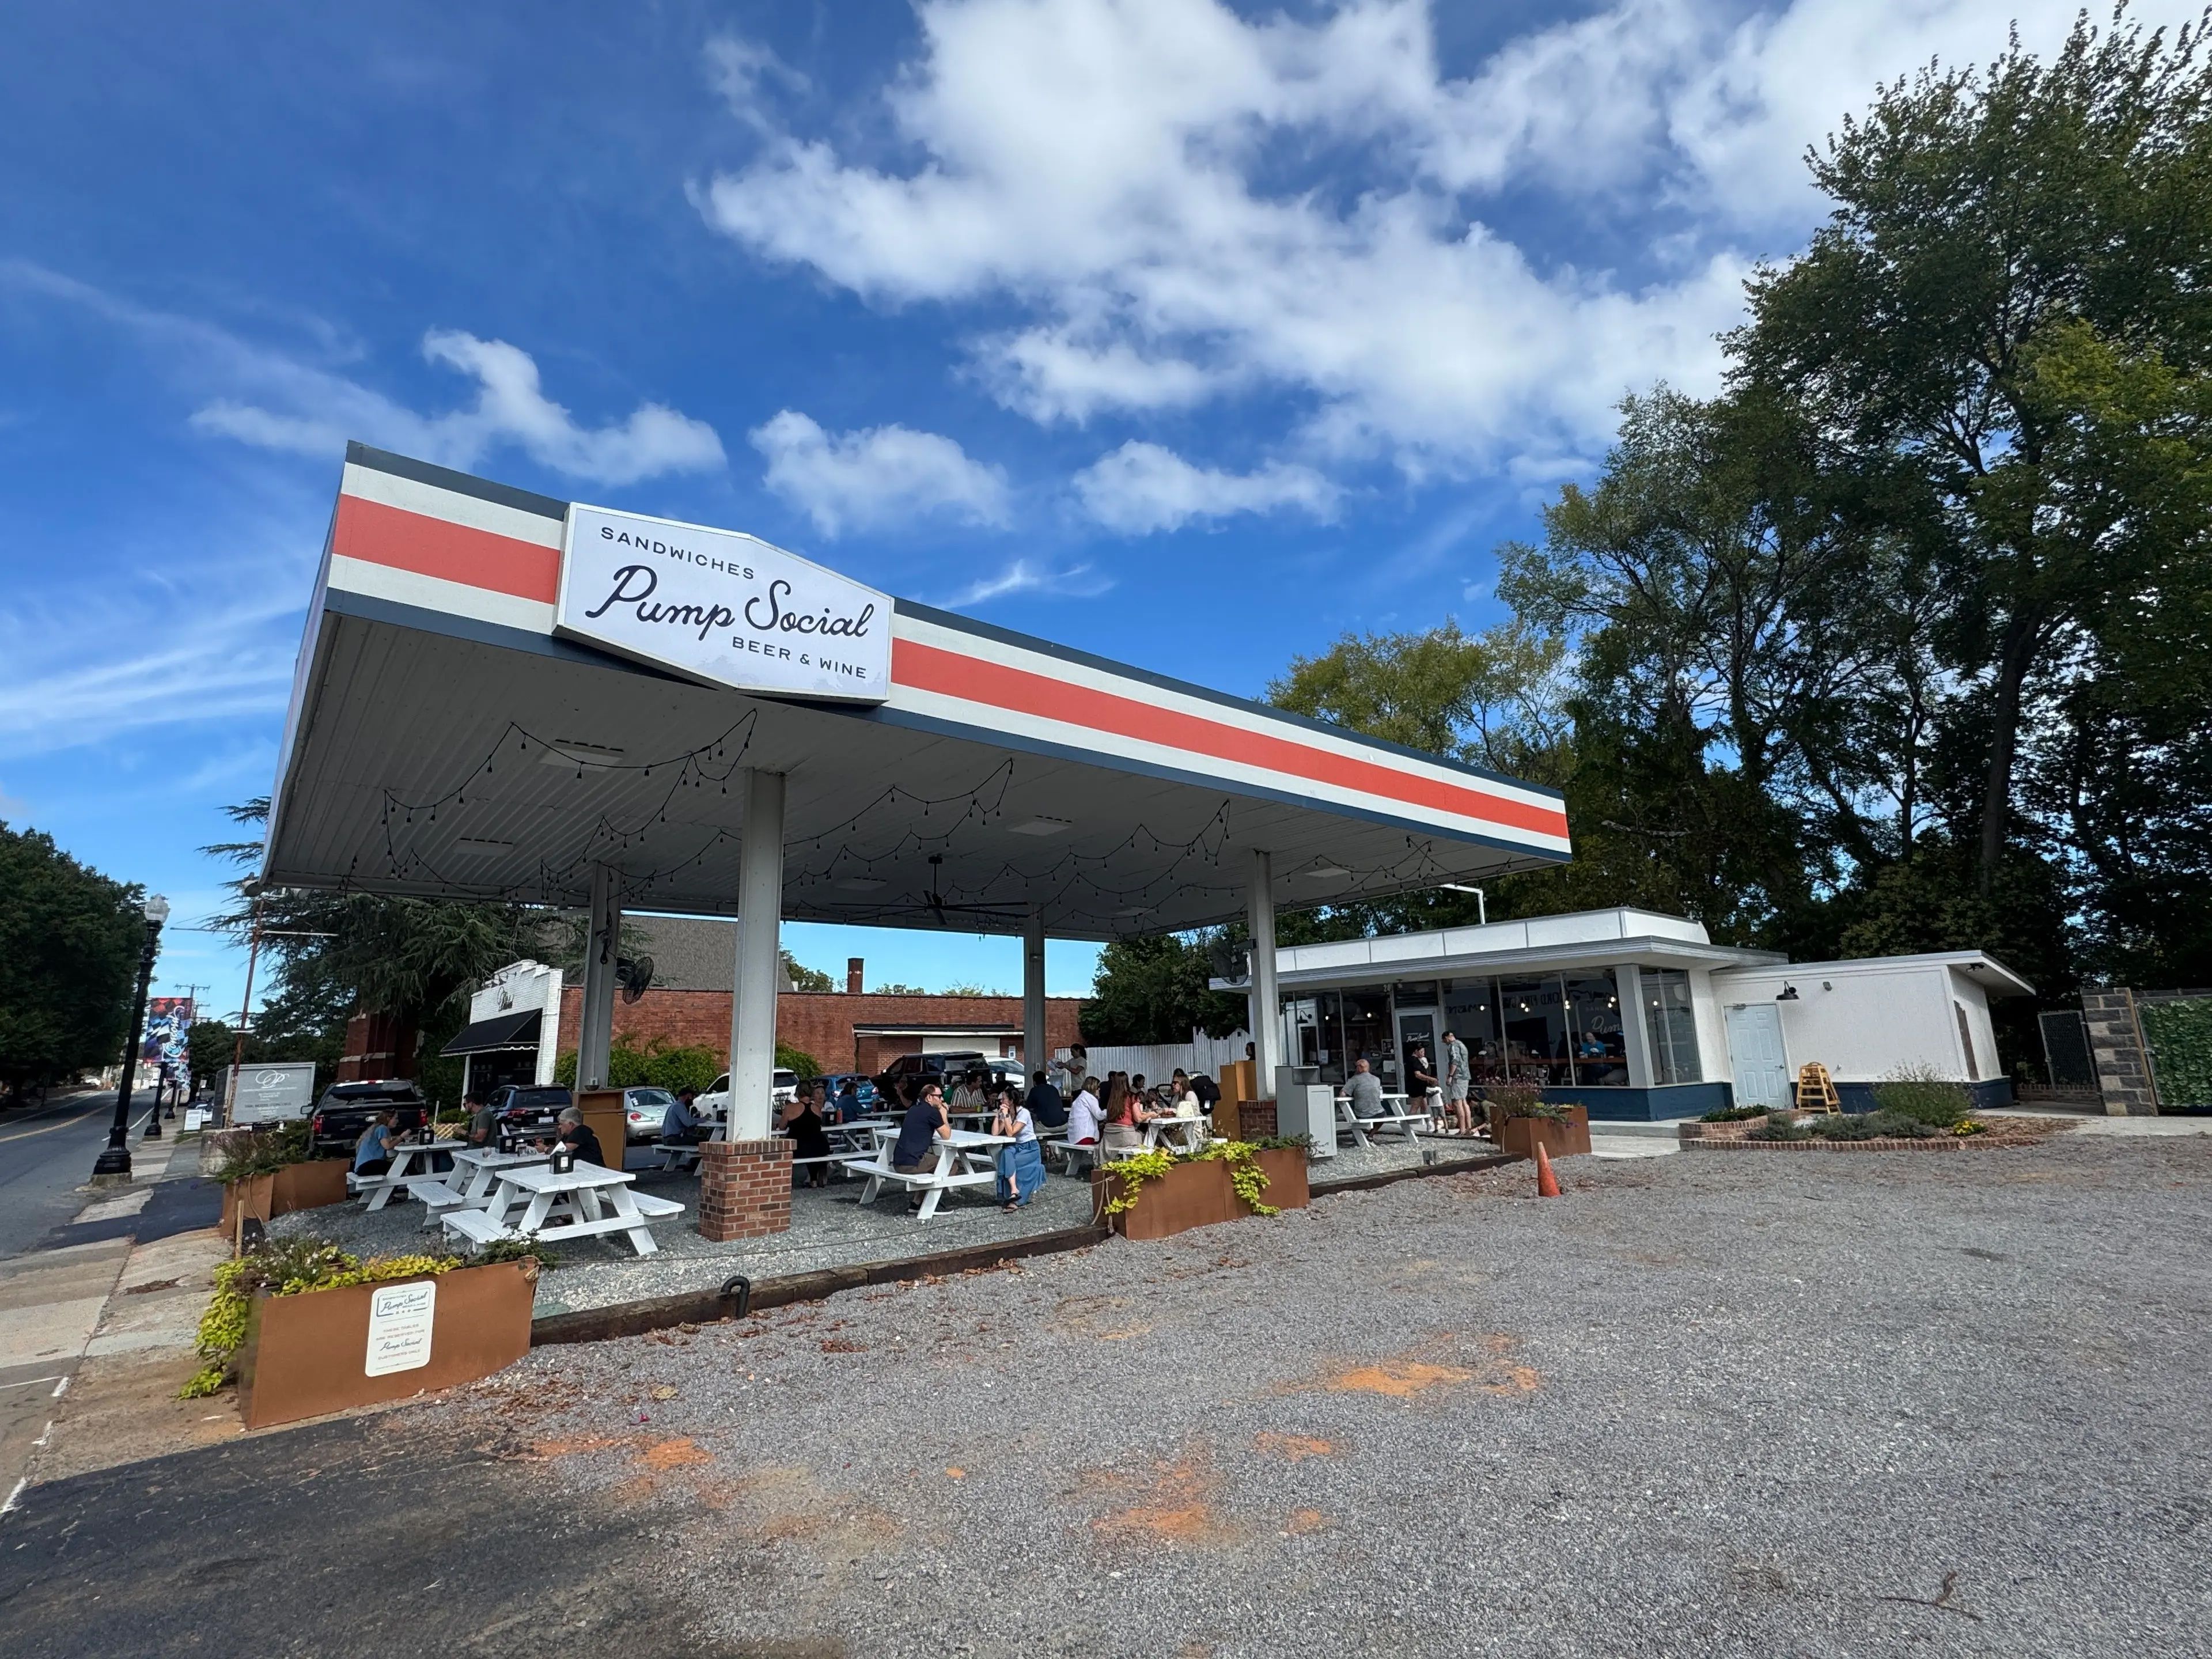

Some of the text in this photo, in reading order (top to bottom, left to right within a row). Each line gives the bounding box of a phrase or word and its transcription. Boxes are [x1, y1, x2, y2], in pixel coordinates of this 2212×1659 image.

[601, 526, 754, 580] SANDWICHES
[585, 565, 874, 641] Pump Social
[732, 636, 866, 679] BEER & WINE
